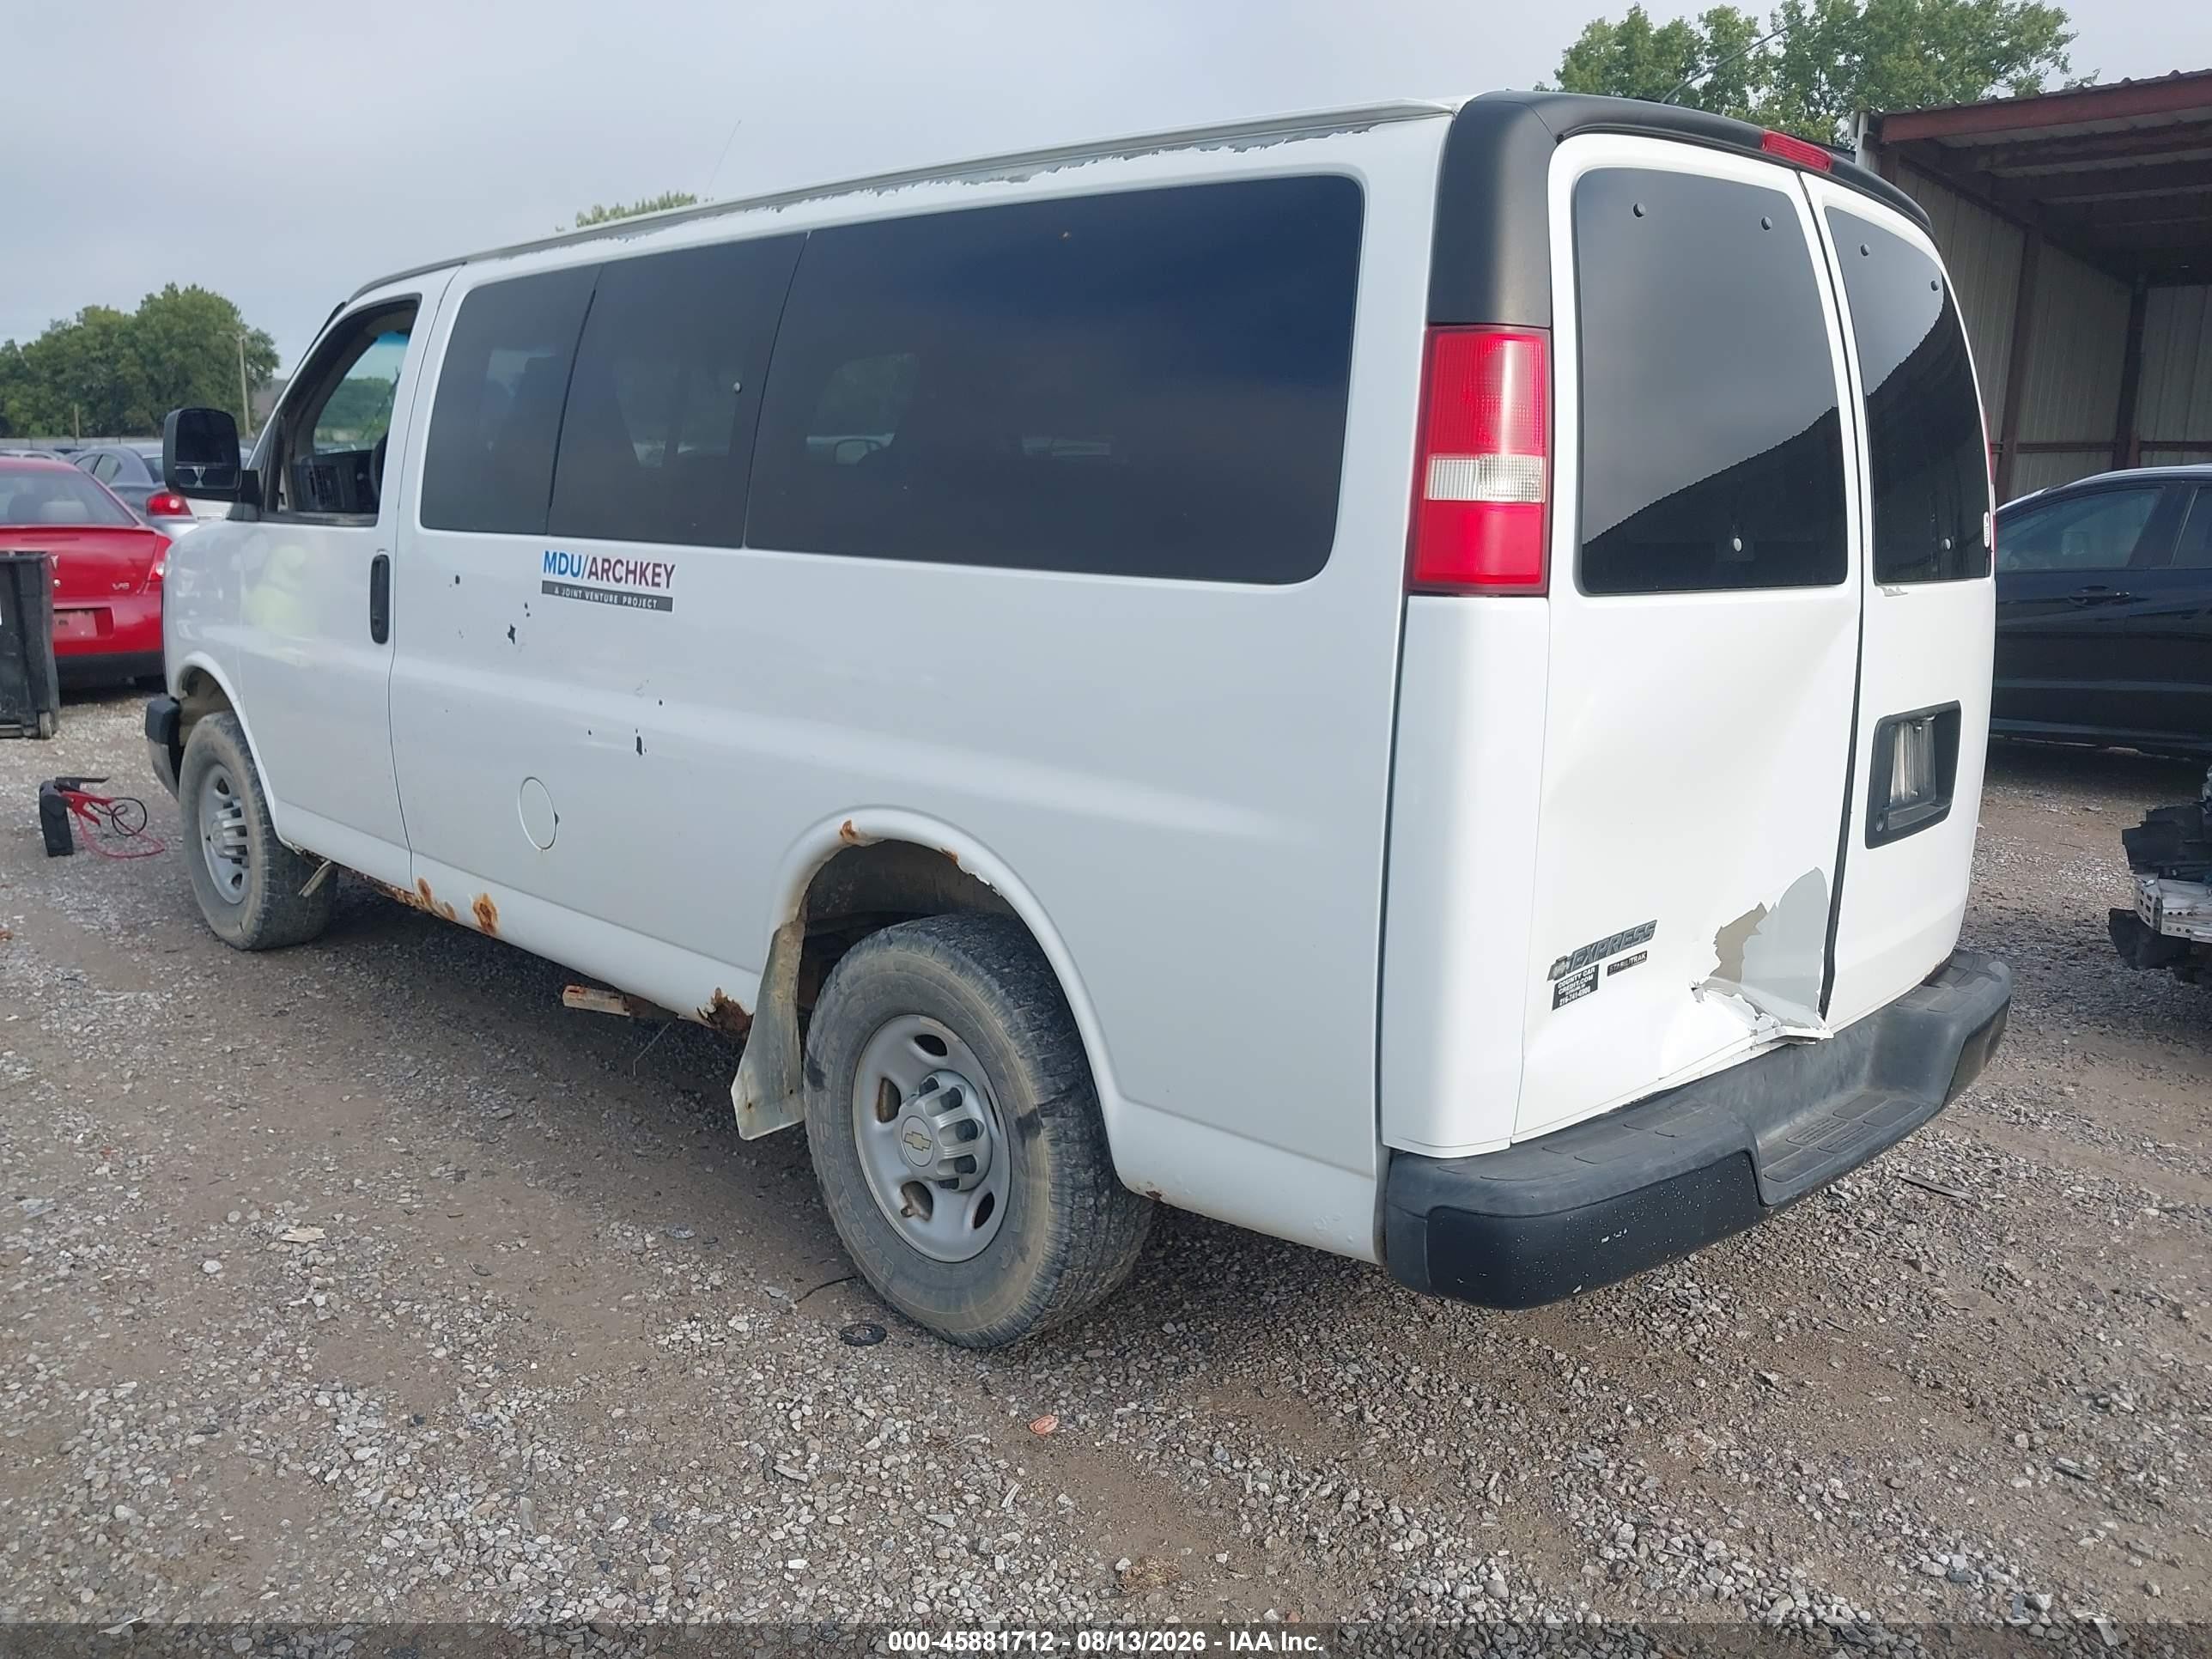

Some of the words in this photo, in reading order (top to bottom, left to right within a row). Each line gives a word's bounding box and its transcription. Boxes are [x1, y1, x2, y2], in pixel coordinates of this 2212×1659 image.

[543, 550, 677, 589] MDU/ARCHKEY
[554, 586, 559, 595] A
[562, 588, 583, 599] JOINT
[585, 591, 618, 605] VENTURE
[623, 596, 658, 610] PROJECT
[1570, 921, 1656, 973] EXPRESS
[1608, 951, 1647, 973] STABILITRAK
[1558, 973, 1582, 989] COUNTY
[1583, 967, 1595, 977] CAR
